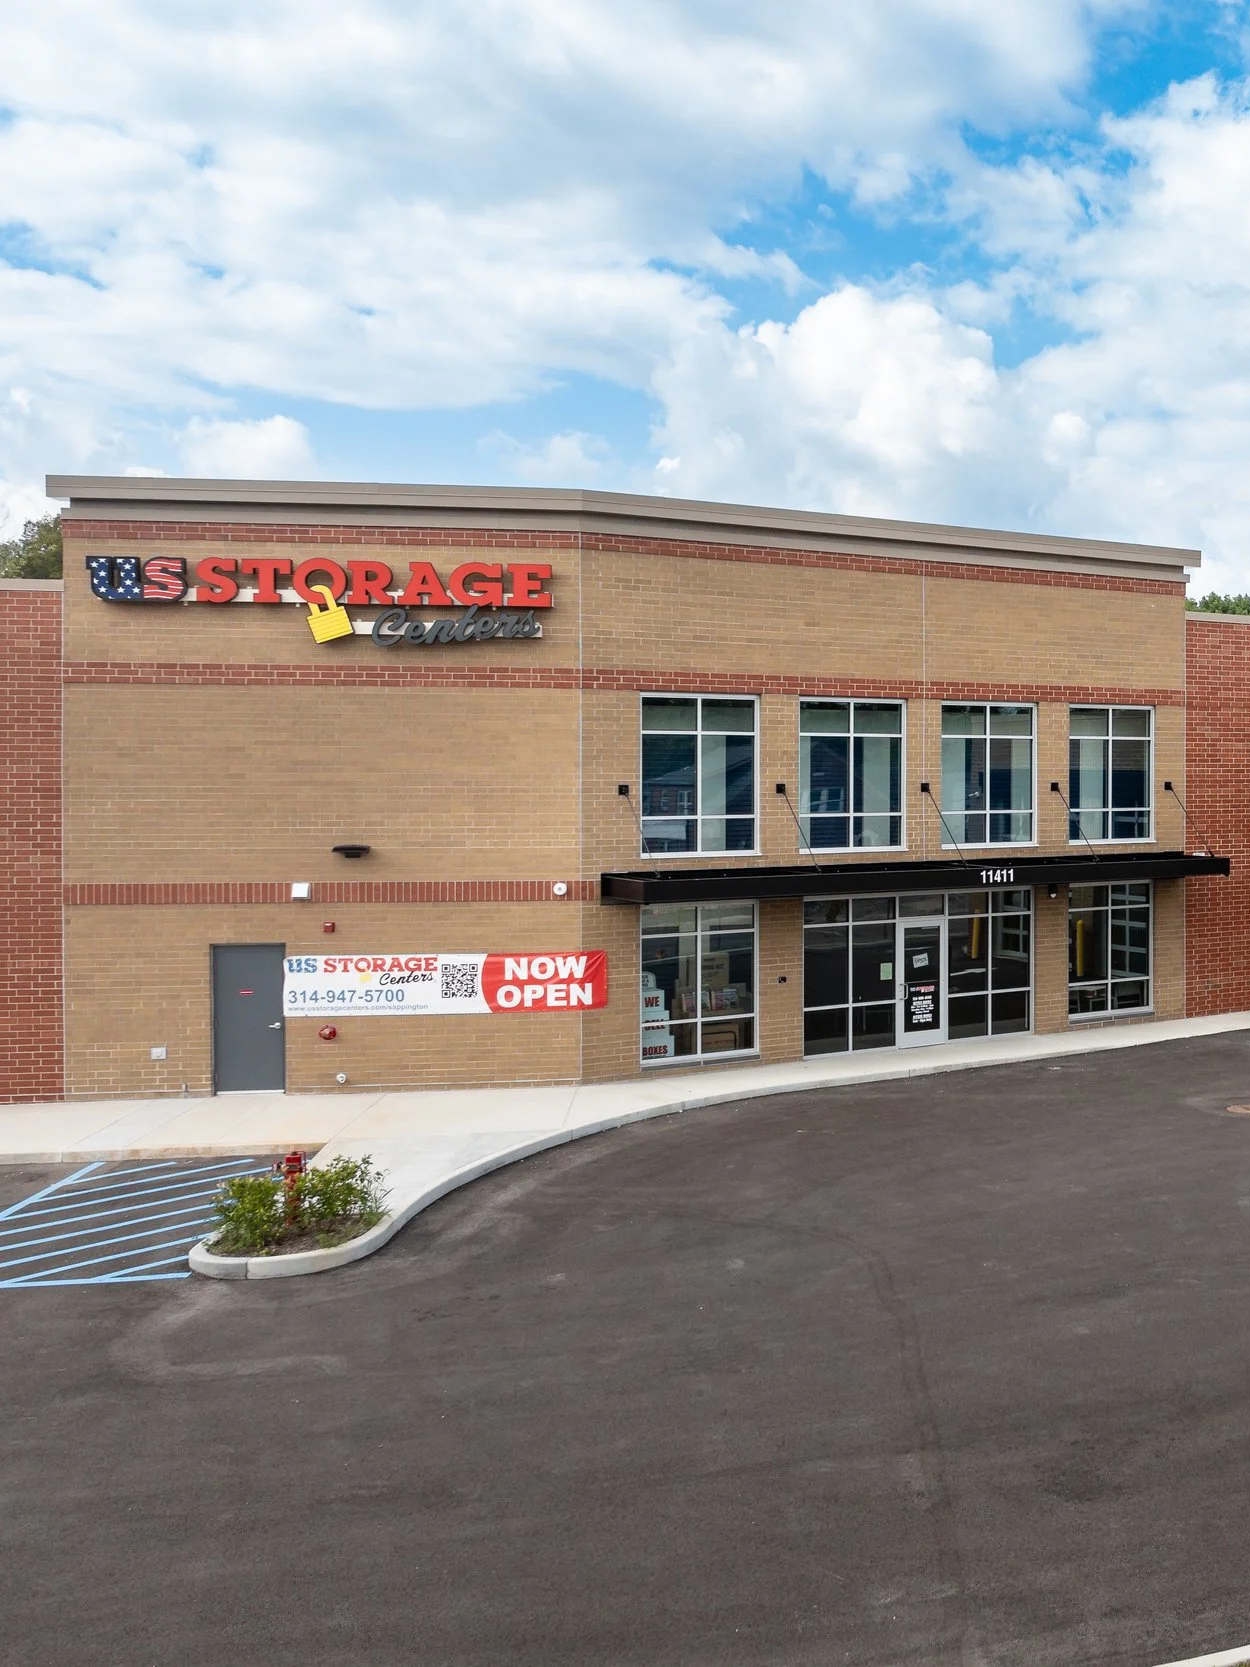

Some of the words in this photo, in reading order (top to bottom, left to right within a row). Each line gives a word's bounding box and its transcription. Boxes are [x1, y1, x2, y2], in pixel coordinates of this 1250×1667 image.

[86, 556, 188, 602] US
[195, 557, 554, 609] STORAGE
[371, 604, 541, 647] Centers
[980, 868, 1014, 884] 11411
[287, 957, 318, 974] US
[323, 956, 438, 974] STORAGE
[504, 956, 588, 981] NOW
[379, 971, 434, 986] Centers
[288, 989, 405, 1004] 314-947-5700
[496, 983, 593, 1008] OPEN
[644, 996, 660, 1008] WE
[288, 1004, 429, 1012] www.usstoragecenters.com/sappington
[642, 1045, 668, 1057] BOXES
